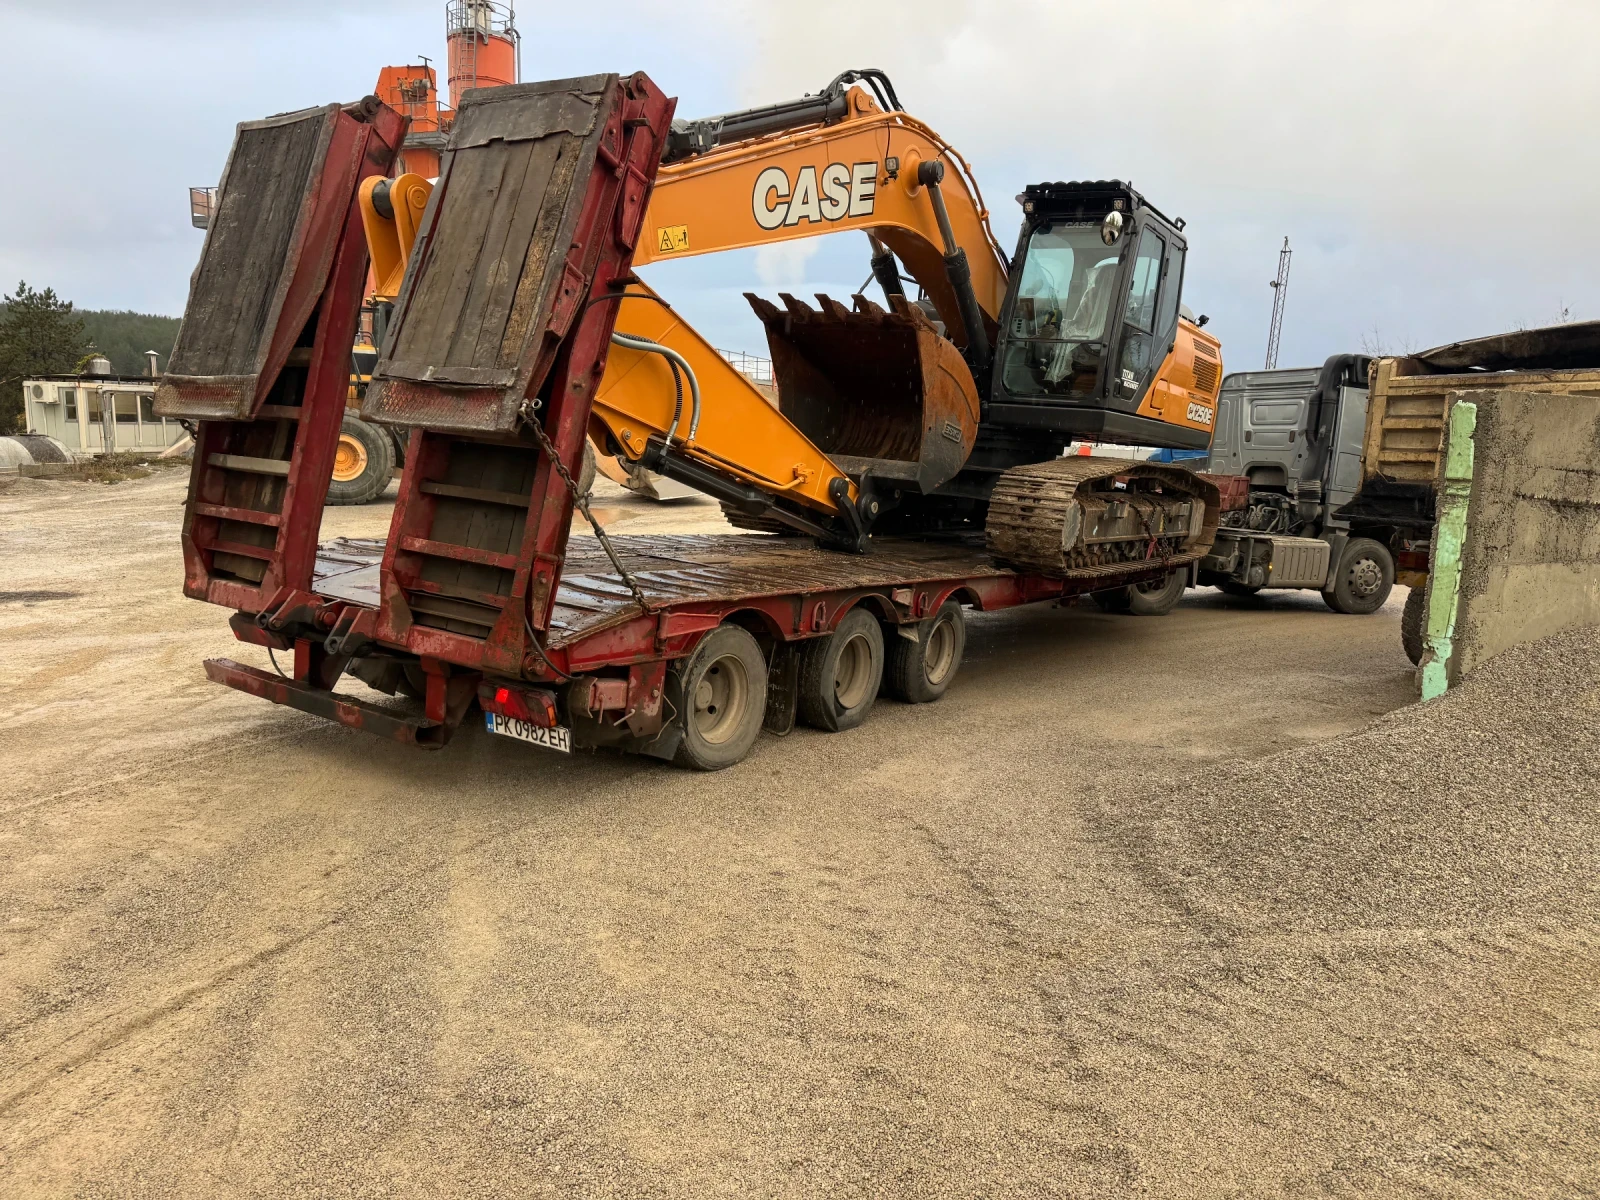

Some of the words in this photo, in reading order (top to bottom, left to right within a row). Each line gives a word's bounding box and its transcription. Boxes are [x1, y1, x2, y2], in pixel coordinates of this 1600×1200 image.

[752, 162, 878, 230] CASE
[1064, 221, 1095, 229] CASE
[1186, 401, 1214, 425] CX250E
[495, 715, 513, 735] PK
[514, 719, 547, 744] 0982
[548, 728, 567, 750] EH
